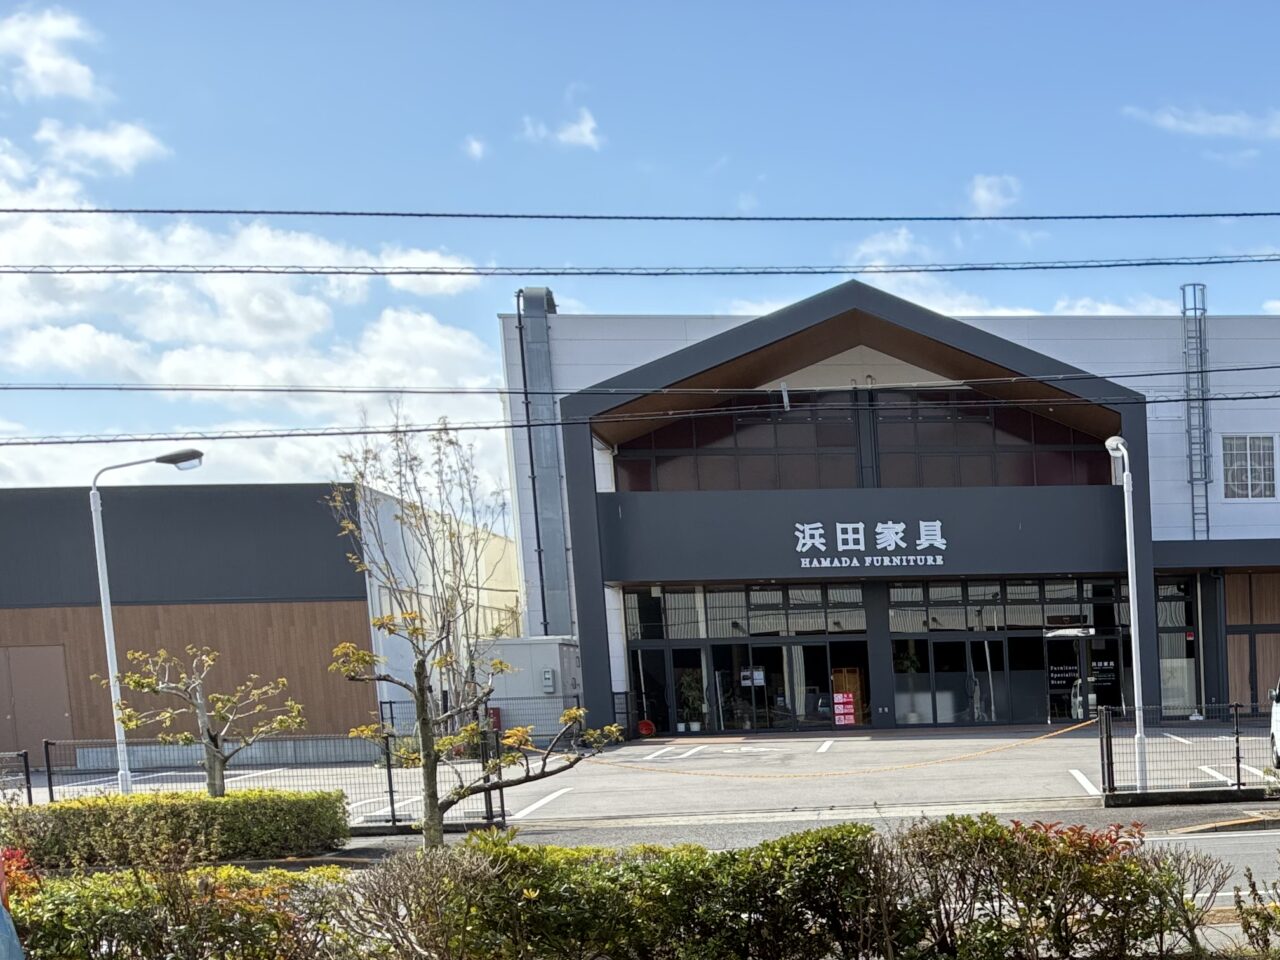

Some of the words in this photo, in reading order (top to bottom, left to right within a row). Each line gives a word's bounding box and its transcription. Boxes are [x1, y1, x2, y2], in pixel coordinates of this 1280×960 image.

[794, 520, 948, 553] 浜田家具
[800, 556, 861, 568] HAMADA
[864, 555, 944, 567] FURNITURE
